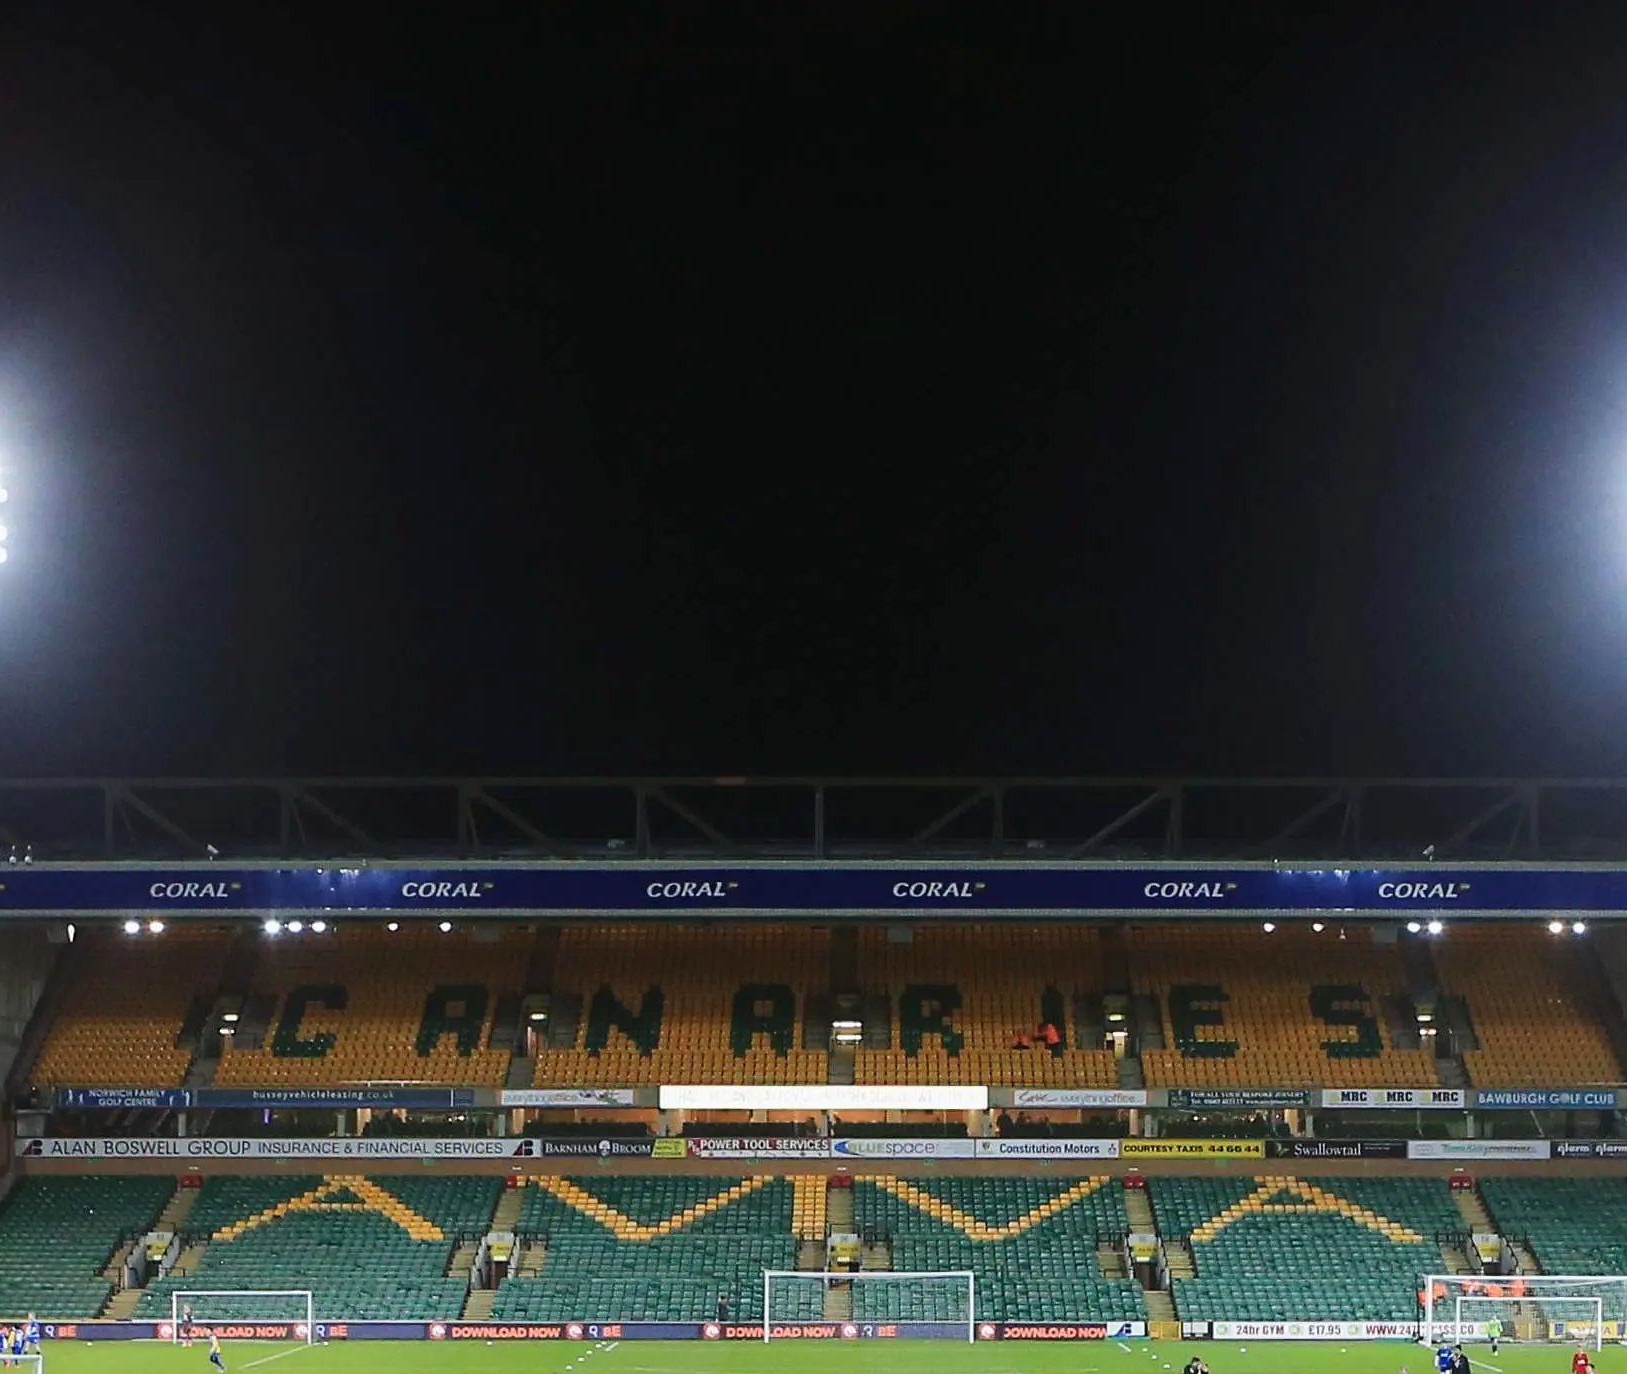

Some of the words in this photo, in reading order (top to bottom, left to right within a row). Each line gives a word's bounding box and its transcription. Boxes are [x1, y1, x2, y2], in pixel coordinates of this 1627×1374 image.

[150, 882, 229, 898] CORAL
[402, 882, 482, 898] CORAL
[647, 882, 726, 898] CORAL
[893, 882, 972, 898] CORAL
[1145, 882, 1224, 898] CORAL
[1378, 882, 1459, 898] CORAL
[1341, 1091, 1367, 1101] MRC
[1387, 1091, 1412, 1101] MRC
[1432, 1091, 1458, 1101] MRC
[1479, 1093, 1545, 1104] BAWBURGH
[1584, 1093, 1614, 1104] CLUB
[51, 1141, 96, 1155] ALAN
[104, 1141, 180, 1155] BOSWELL
[187, 1141, 251, 1155] GROUP
[258, 1142, 339, 1154] INSURANCE
[343, 1142, 352, 1154] &
[357, 1142, 429, 1154] FINANCIAL
[434, 1142, 503, 1154] SERVICES
[545, 1143, 597, 1154] BARNHAM
[612, 1143, 651, 1154] BROOM
[700, 1139, 740, 1150] POWER
[743, 1139, 772, 1150] TOOL
[775, 1139, 829, 1150] SERVICES
[999, 1143, 1061, 1154] Constitution
[1064, 1143, 1100, 1154] Motors
[1294, 1143, 1361, 1156] Swallowtail
[58, 1326, 76, 1337] BE
[256, 1326, 287, 1337] NOW
[452, 1326, 526, 1337] DOWNLOAD
[528, 1326, 560, 1337] NOW
[603, 1326, 621, 1337] BE
[803, 1326, 835, 1337] NOW
[878, 1326, 896, 1337] BE
[1078, 1327, 1108, 1338] NOW
[1236, 1325, 1259, 1335] 24hr
[1262, 1325, 1284, 1335] GYM
